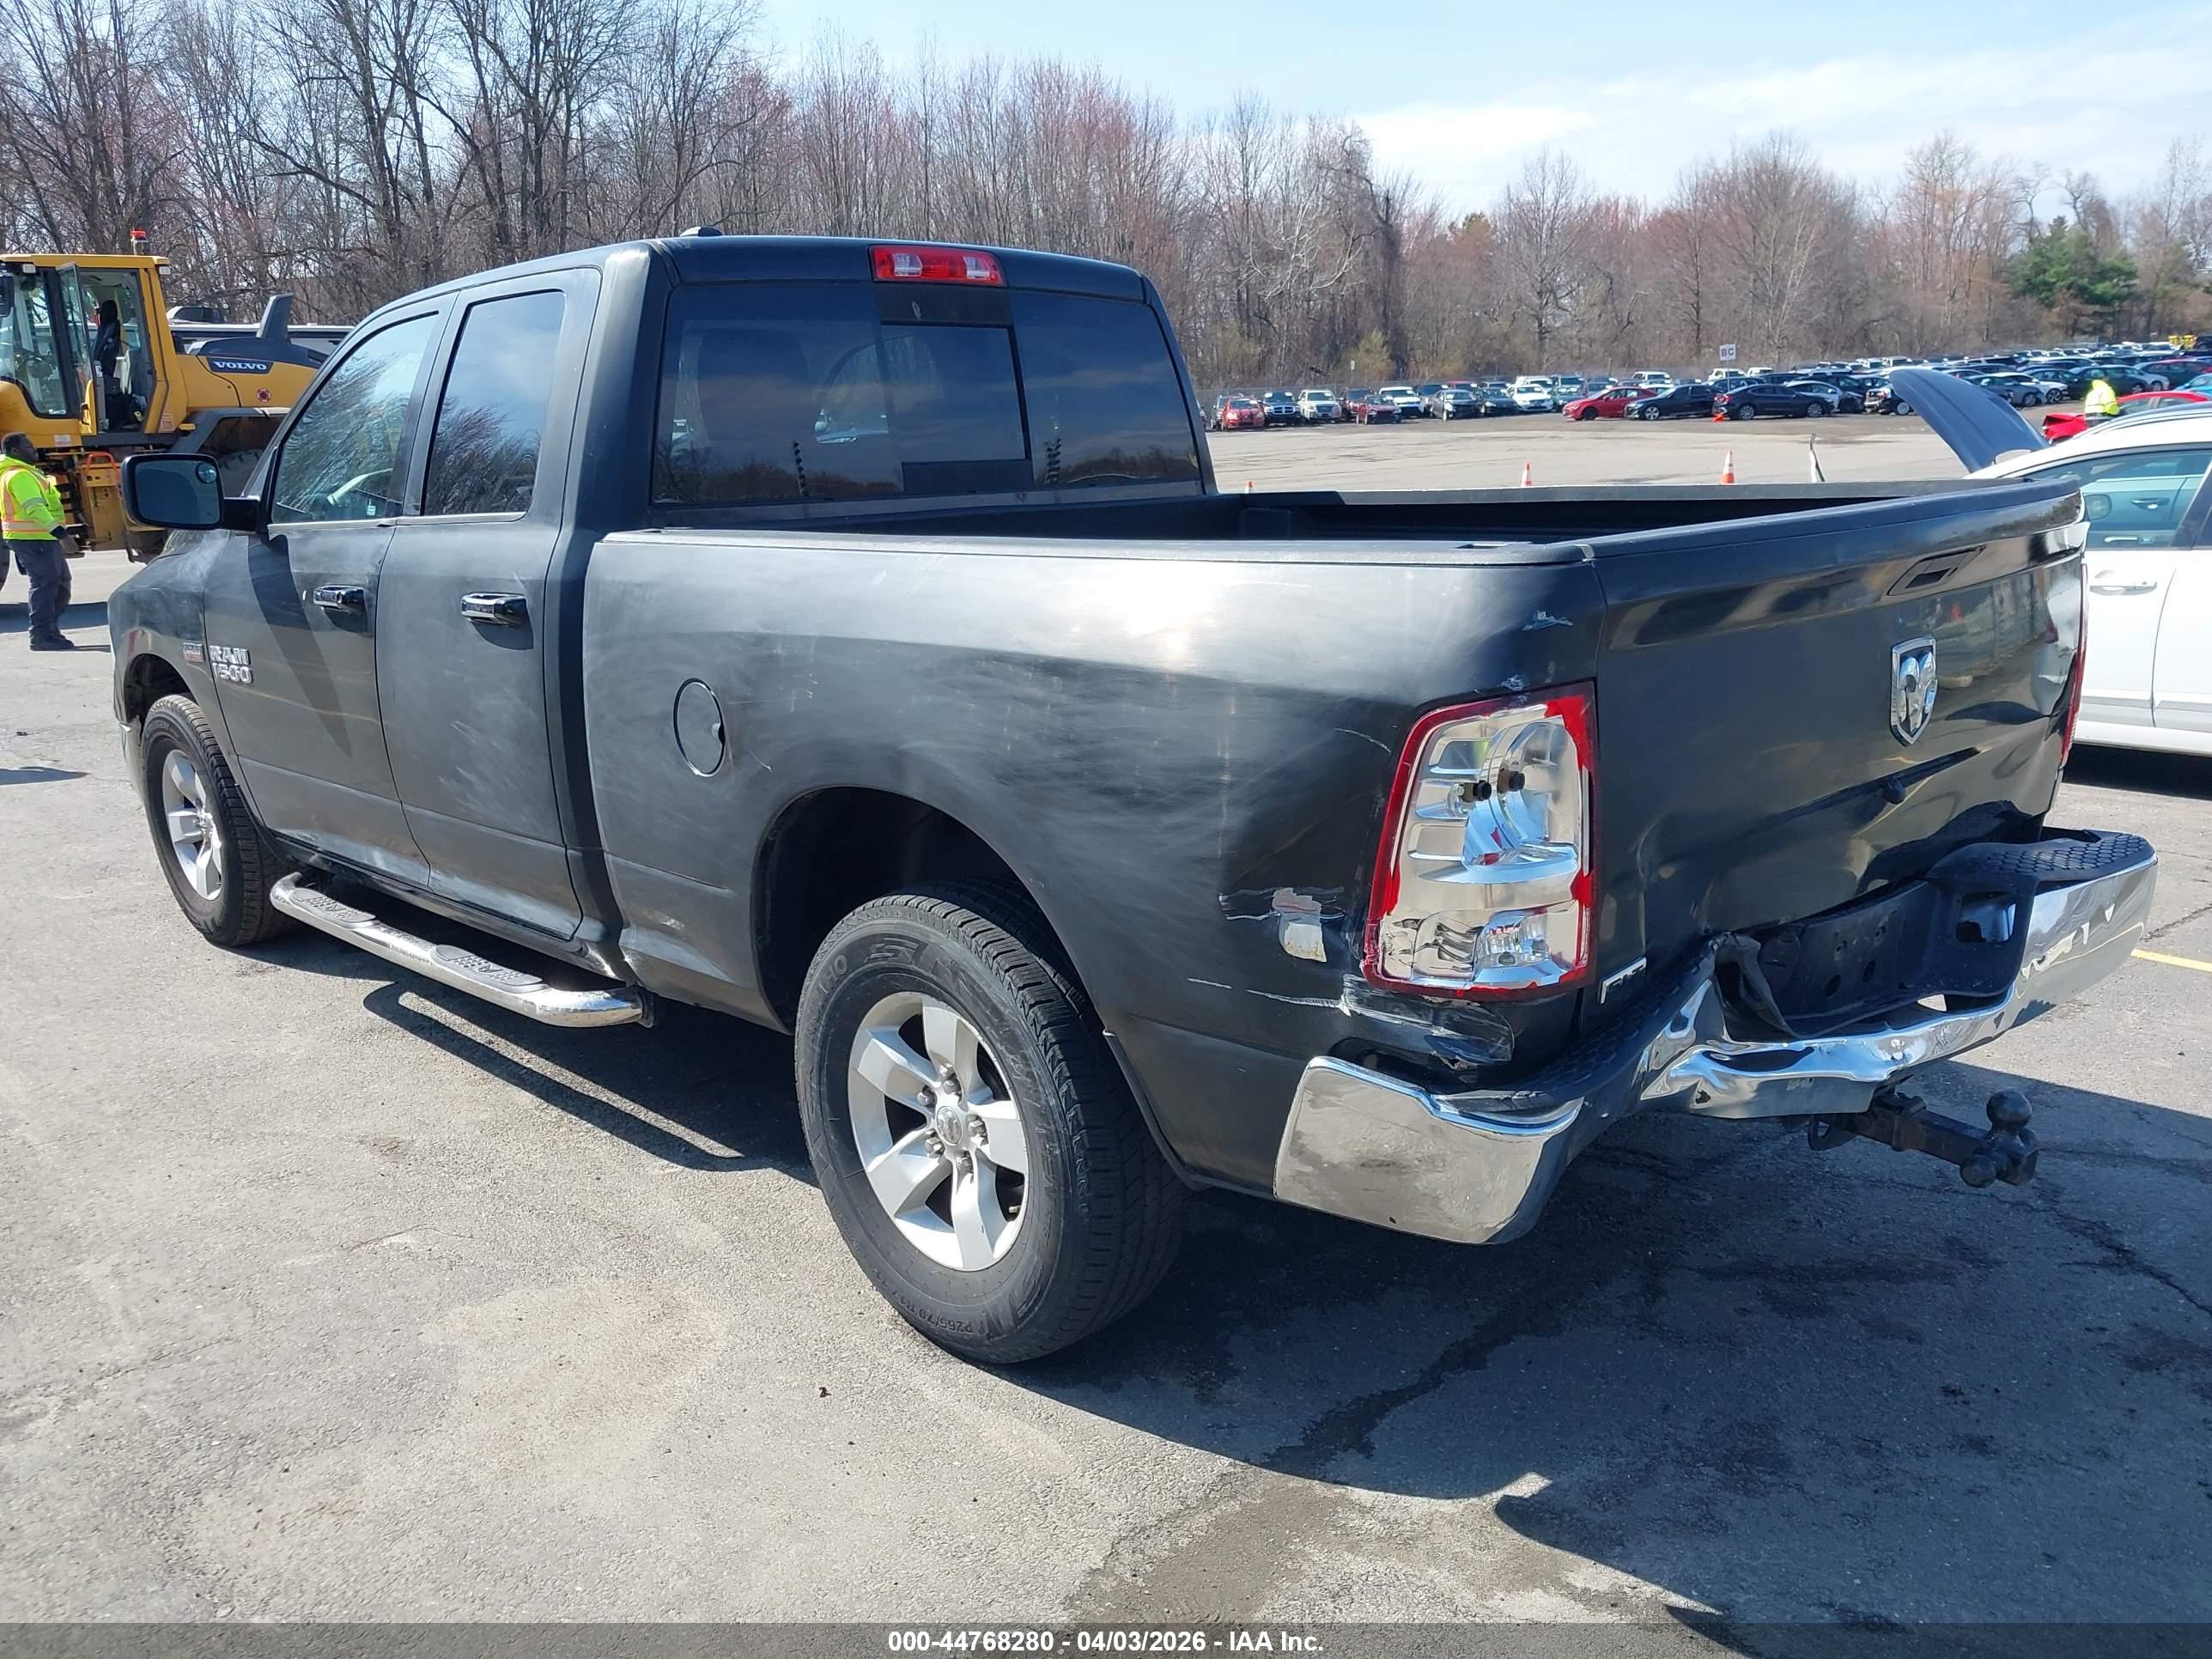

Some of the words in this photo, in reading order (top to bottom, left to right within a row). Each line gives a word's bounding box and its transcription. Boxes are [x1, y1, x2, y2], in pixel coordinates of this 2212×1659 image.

[212, 361, 267, 371] VOLVO
[209, 645, 251, 665] RAM
[212, 662, 254, 684] 1500
